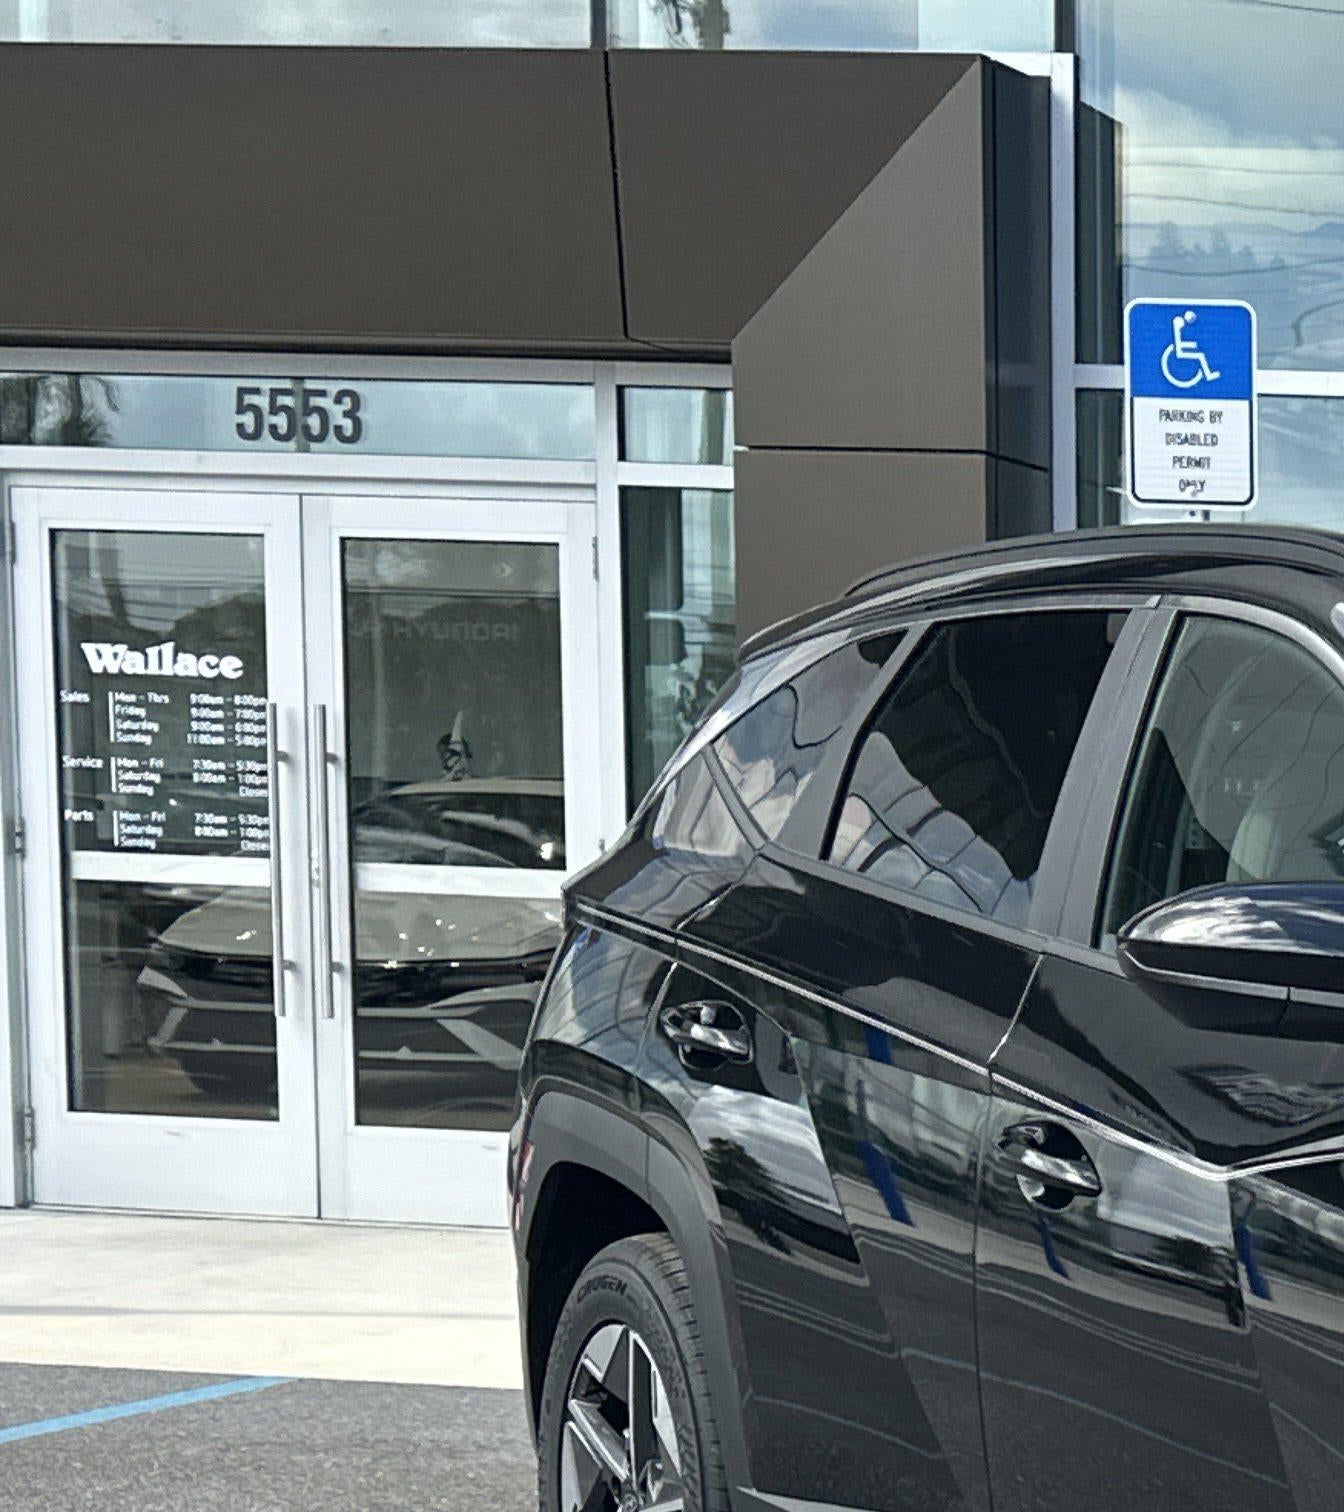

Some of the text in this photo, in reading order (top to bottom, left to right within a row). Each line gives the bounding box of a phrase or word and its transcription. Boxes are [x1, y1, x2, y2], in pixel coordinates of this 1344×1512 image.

[235, 386, 363, 444] 5553
[1159, 409, 1223, 424] PARKING BY
[1165, 432, 1218, 447] DISABLED
[1172, 455, 1211, 470] PERMIT
[80, 641, 244, 679] Wallace
[62, 755, 104, 769] Service
